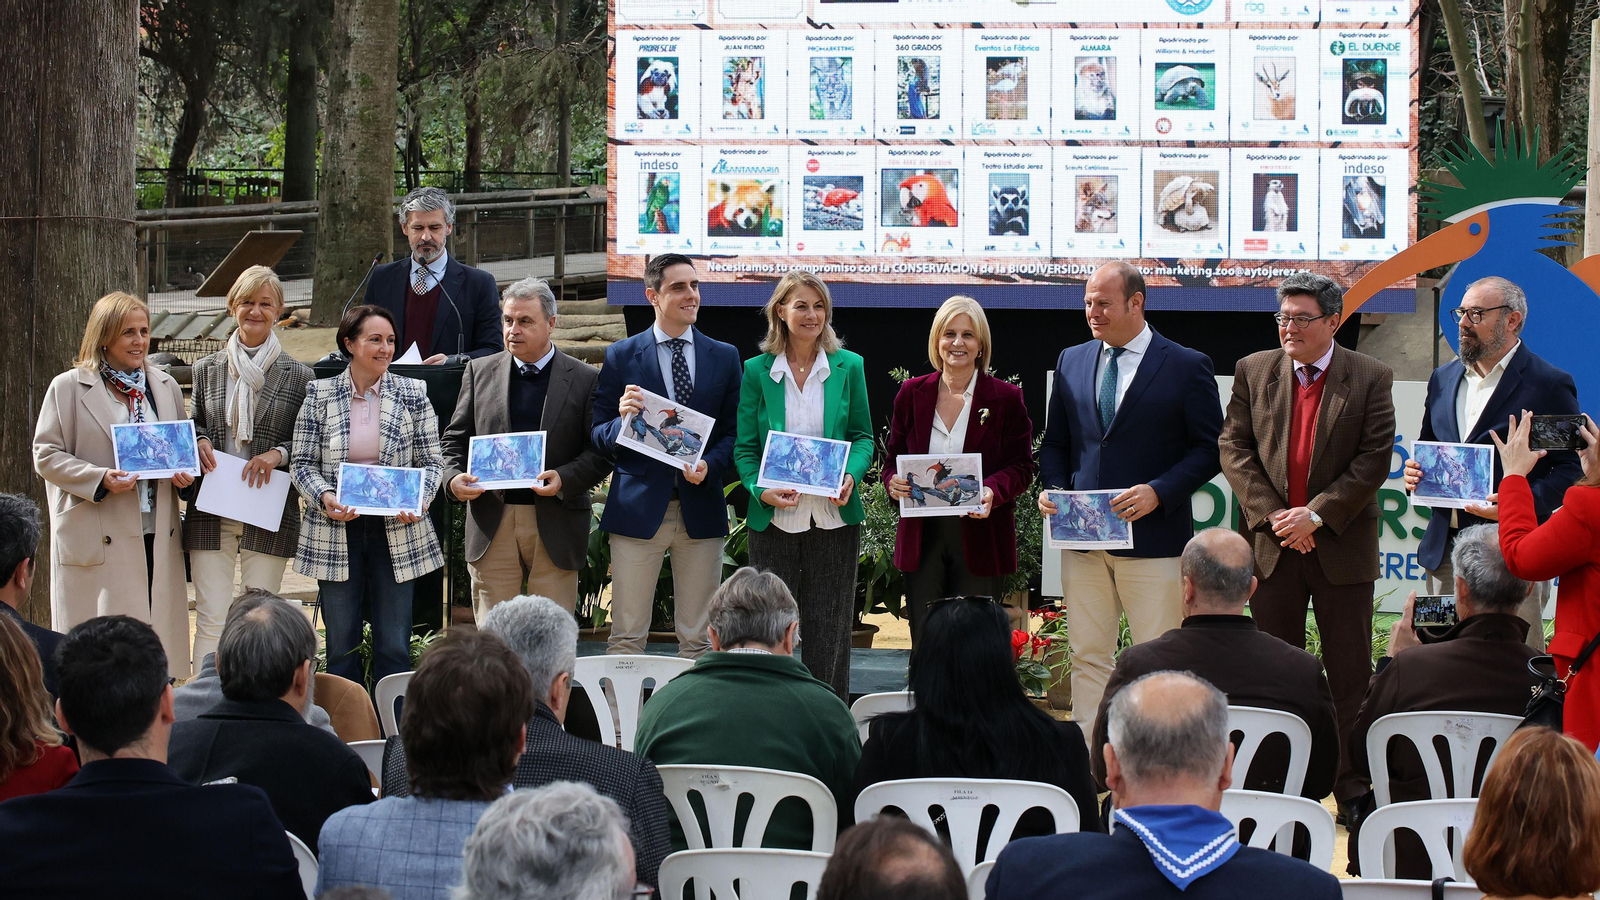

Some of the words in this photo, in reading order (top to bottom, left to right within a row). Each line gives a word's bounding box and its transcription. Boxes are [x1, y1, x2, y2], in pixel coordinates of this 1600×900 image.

[718, 34, 756, 42] Apadrinado
[1348, 42, 1359, 51] EL
[1362, 42, 1400, 51] DUENDE
[640, 158, 678, 170] indeso
[1344, 162, 1384, 174] indeso
[707, 262, 774, 272] Necesitamos
[776, 263, 787, 272] tu
[790, 262, 856, 274] compromiso
[858, 265, 877, 273] con
[880, 263, 890, 273] la
[892, 262, 978, 274] CONSERVACIÓN
[980, 263, 994, 273] de
[996, 263, 1006, 273] la
[1009, 264, 1094, 274] BIODIVERSIDAD
[1155, 265, 1310, 279] marketing.zoo@aytojerezes
